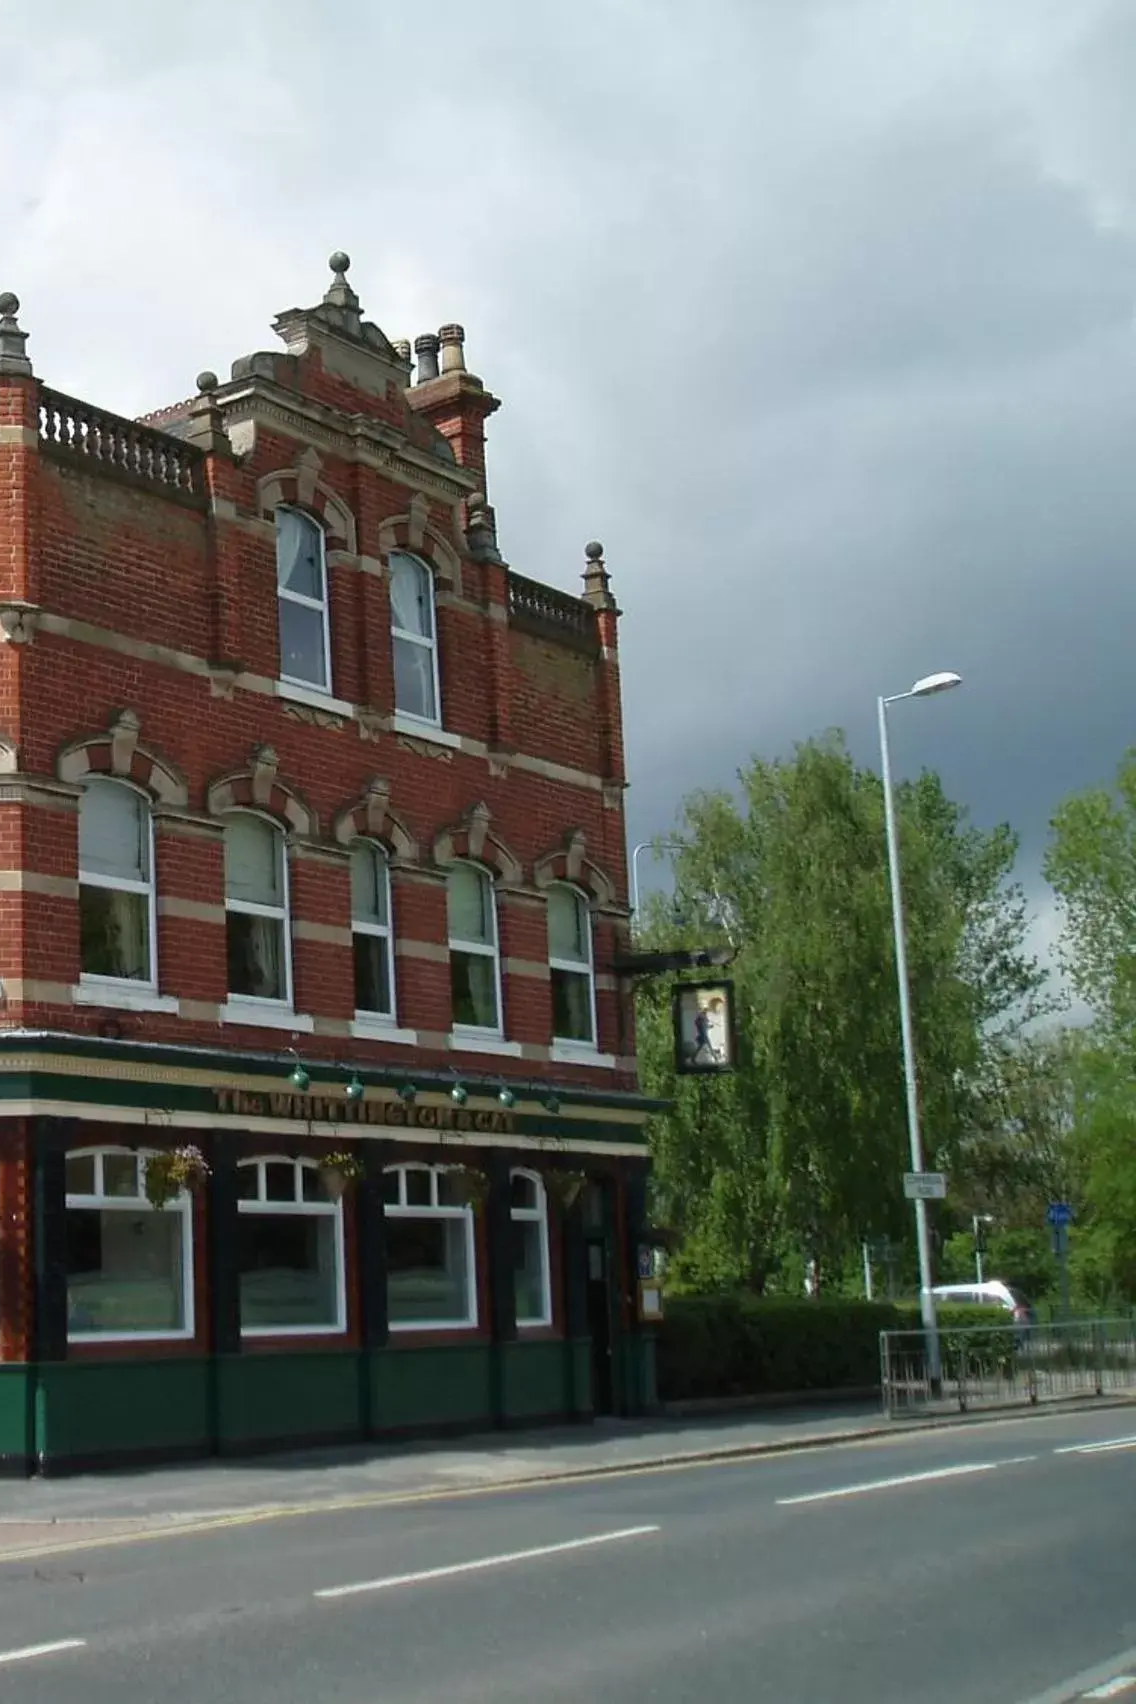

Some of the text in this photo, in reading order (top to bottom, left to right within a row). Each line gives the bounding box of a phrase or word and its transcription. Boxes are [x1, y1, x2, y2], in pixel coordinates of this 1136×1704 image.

[212, 1086, 262, 1115] The
[268, 1091, 452, 1131] WHITTINGTON
[475, 1110, 517, 1133] CAT
